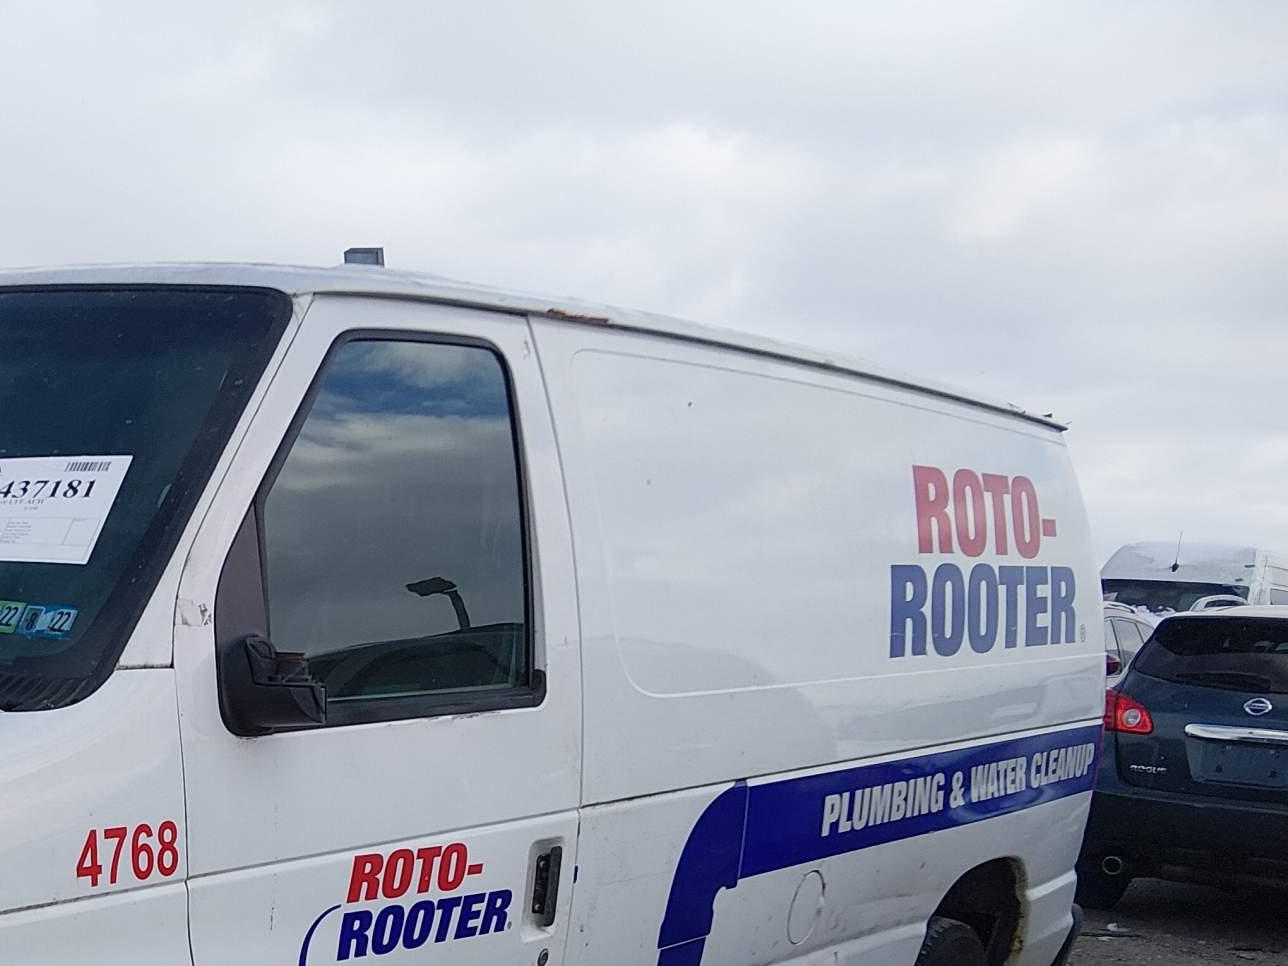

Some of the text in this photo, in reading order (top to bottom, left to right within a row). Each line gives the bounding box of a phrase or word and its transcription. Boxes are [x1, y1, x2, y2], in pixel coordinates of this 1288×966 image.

[912, 465, 1057, 559] ROTO-
[889, 563, 1076, 658] ROOTER
[820, 742, 1096, 837] PLUMBING & WATER CLEANUP
[76, 820, 179, 887] 4768
[346, 842, 484, 903] ROTO-
[336, 889, 513, 961] ROOTER
